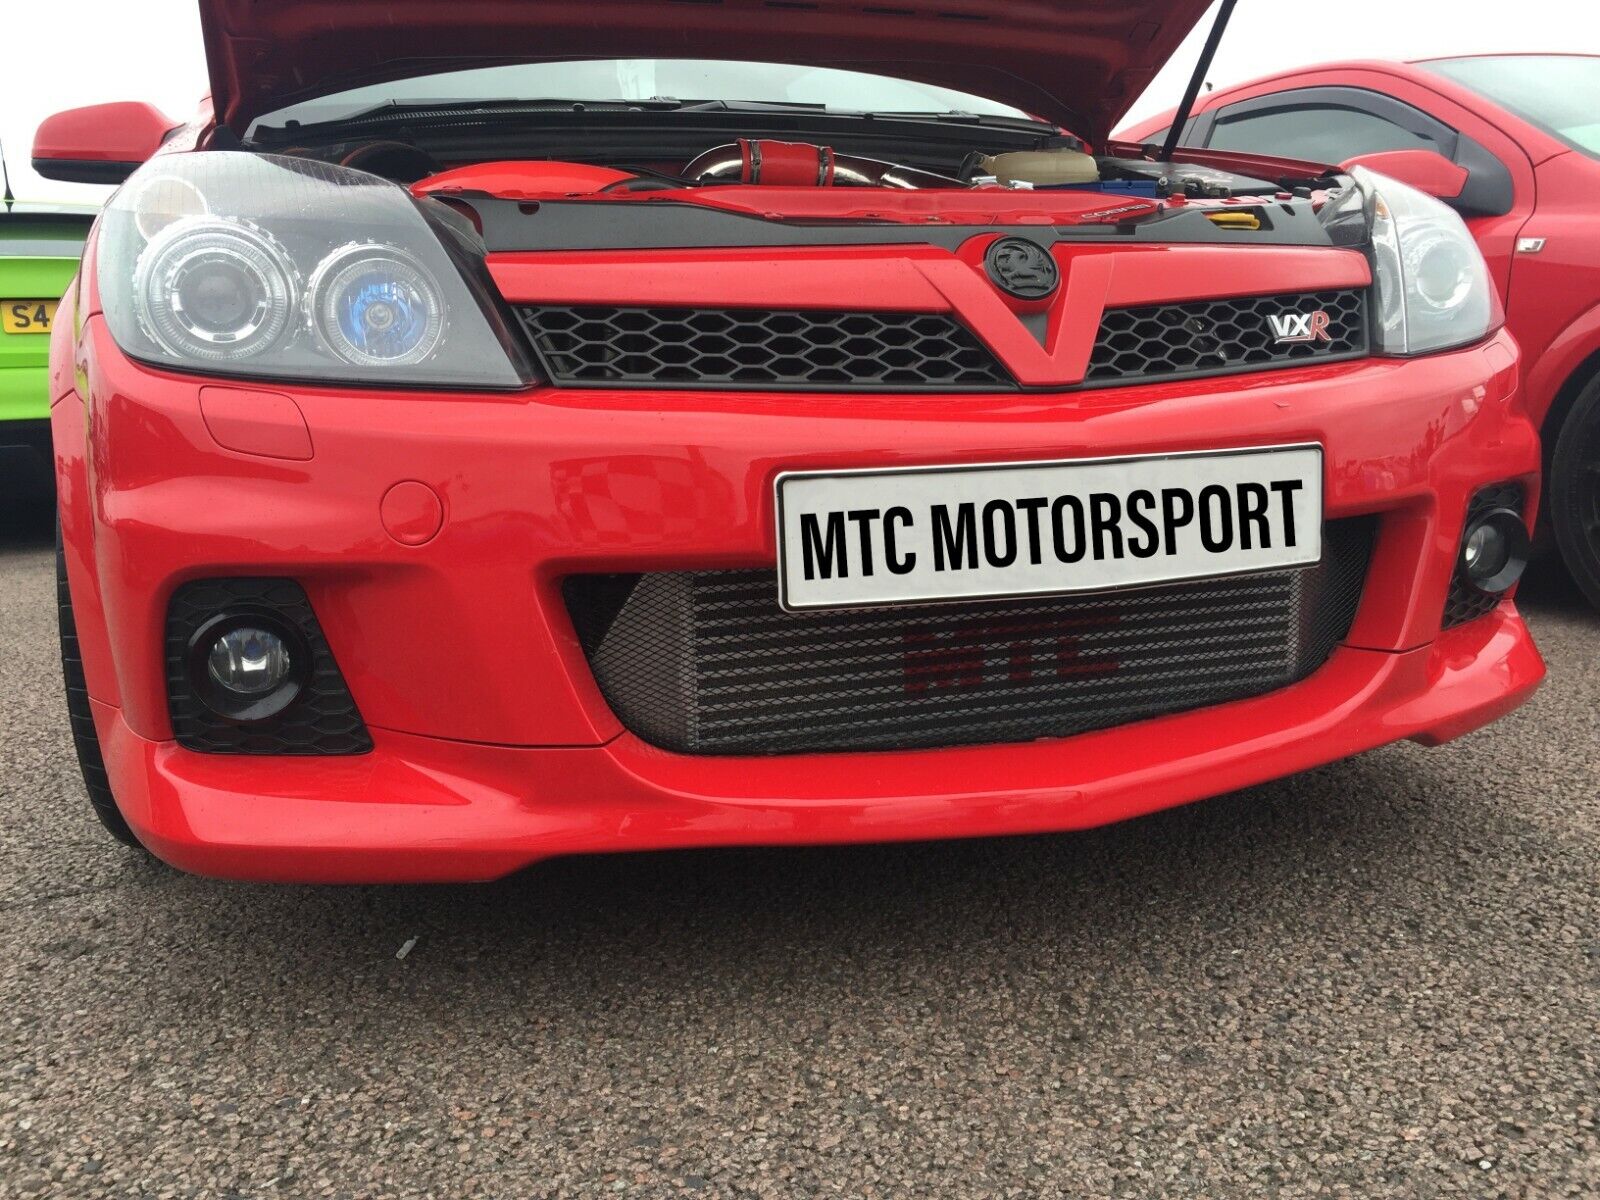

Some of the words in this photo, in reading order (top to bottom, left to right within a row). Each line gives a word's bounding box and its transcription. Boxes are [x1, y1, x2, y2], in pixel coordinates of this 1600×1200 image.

[12, 303, 51, 328] S4
[1266, 310, 1332, 344] VXR
[800, 506, 918, 581] MTC
[930, 479, 1303, 572] MOTORSPORT
